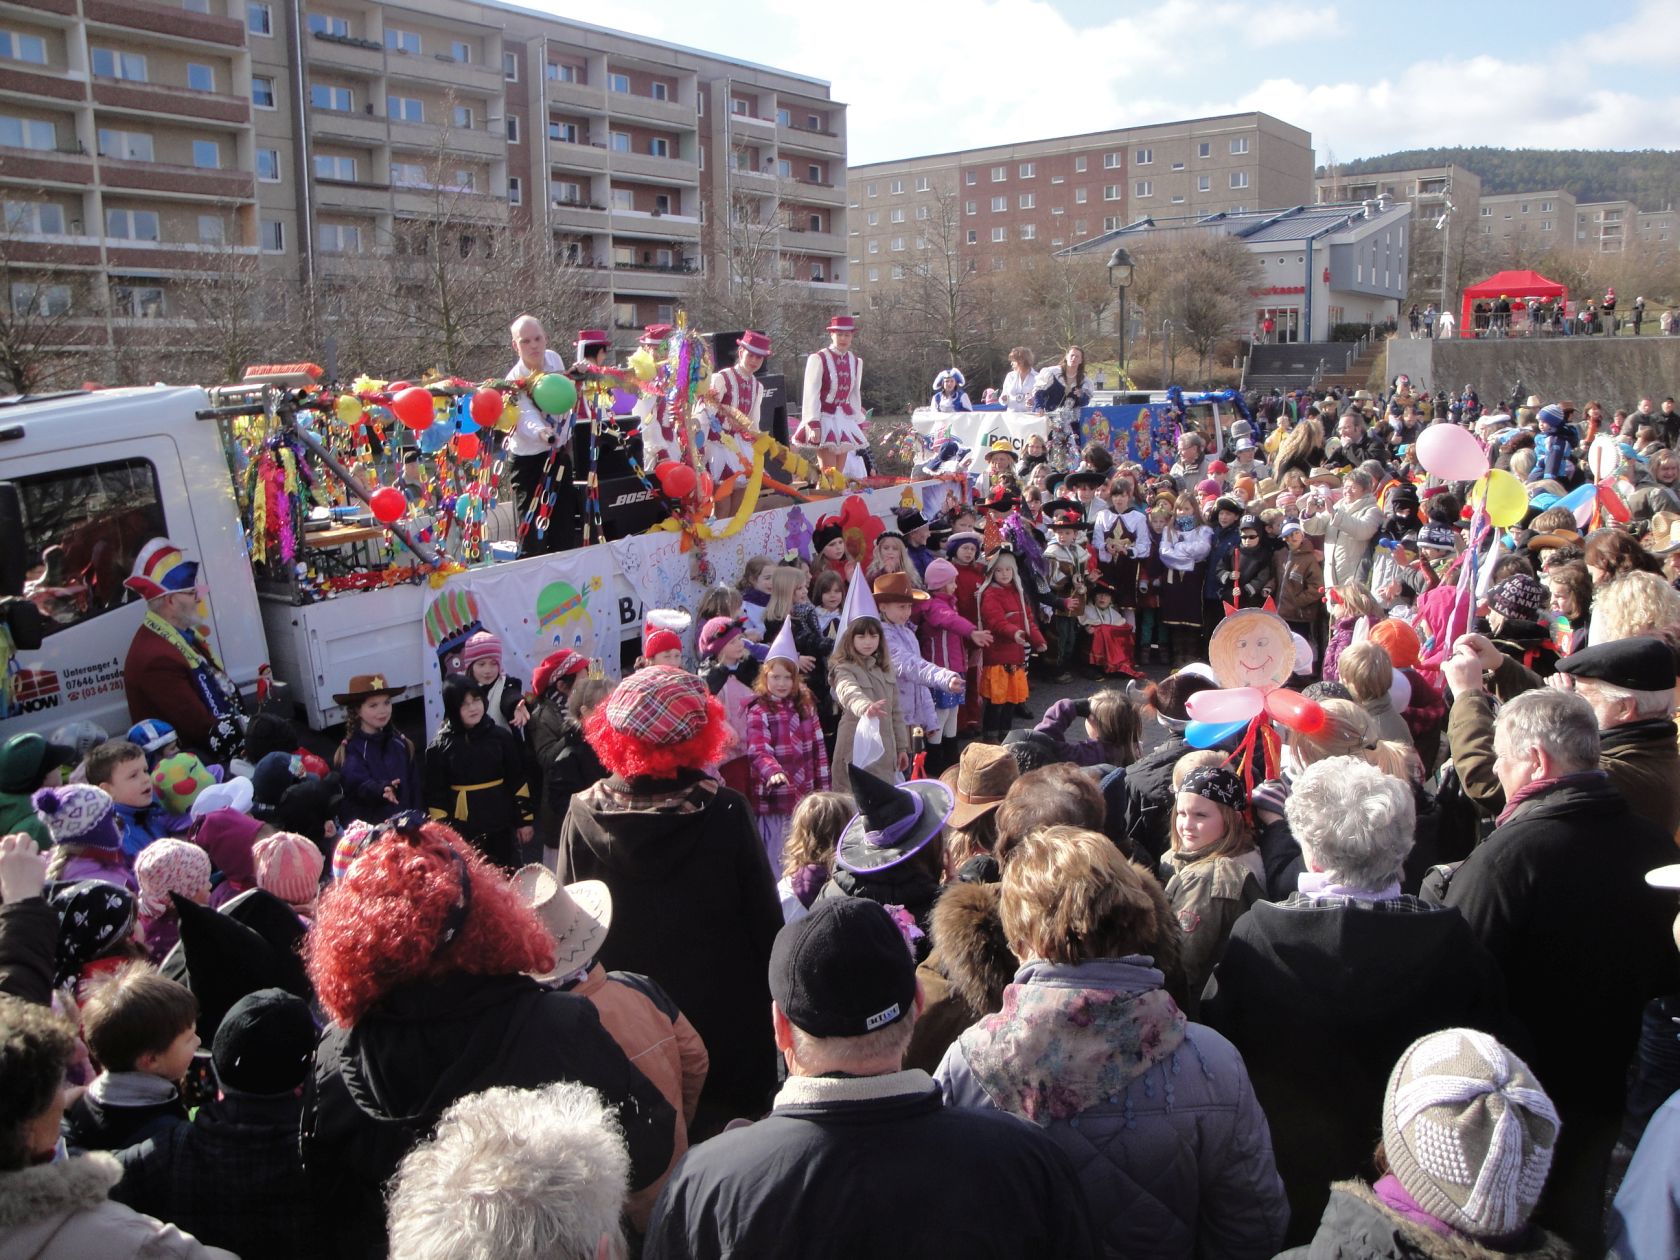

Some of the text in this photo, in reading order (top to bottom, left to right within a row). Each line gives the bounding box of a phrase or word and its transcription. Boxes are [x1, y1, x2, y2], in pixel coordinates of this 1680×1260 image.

[608, 488, 660, 508] BOSE
[63, 657, 119, 678] Unteranger 4
[66, 676, 94, 690] 07646
[82, 686, 96, 700] (03
[98, 684, 108, 693] 64
